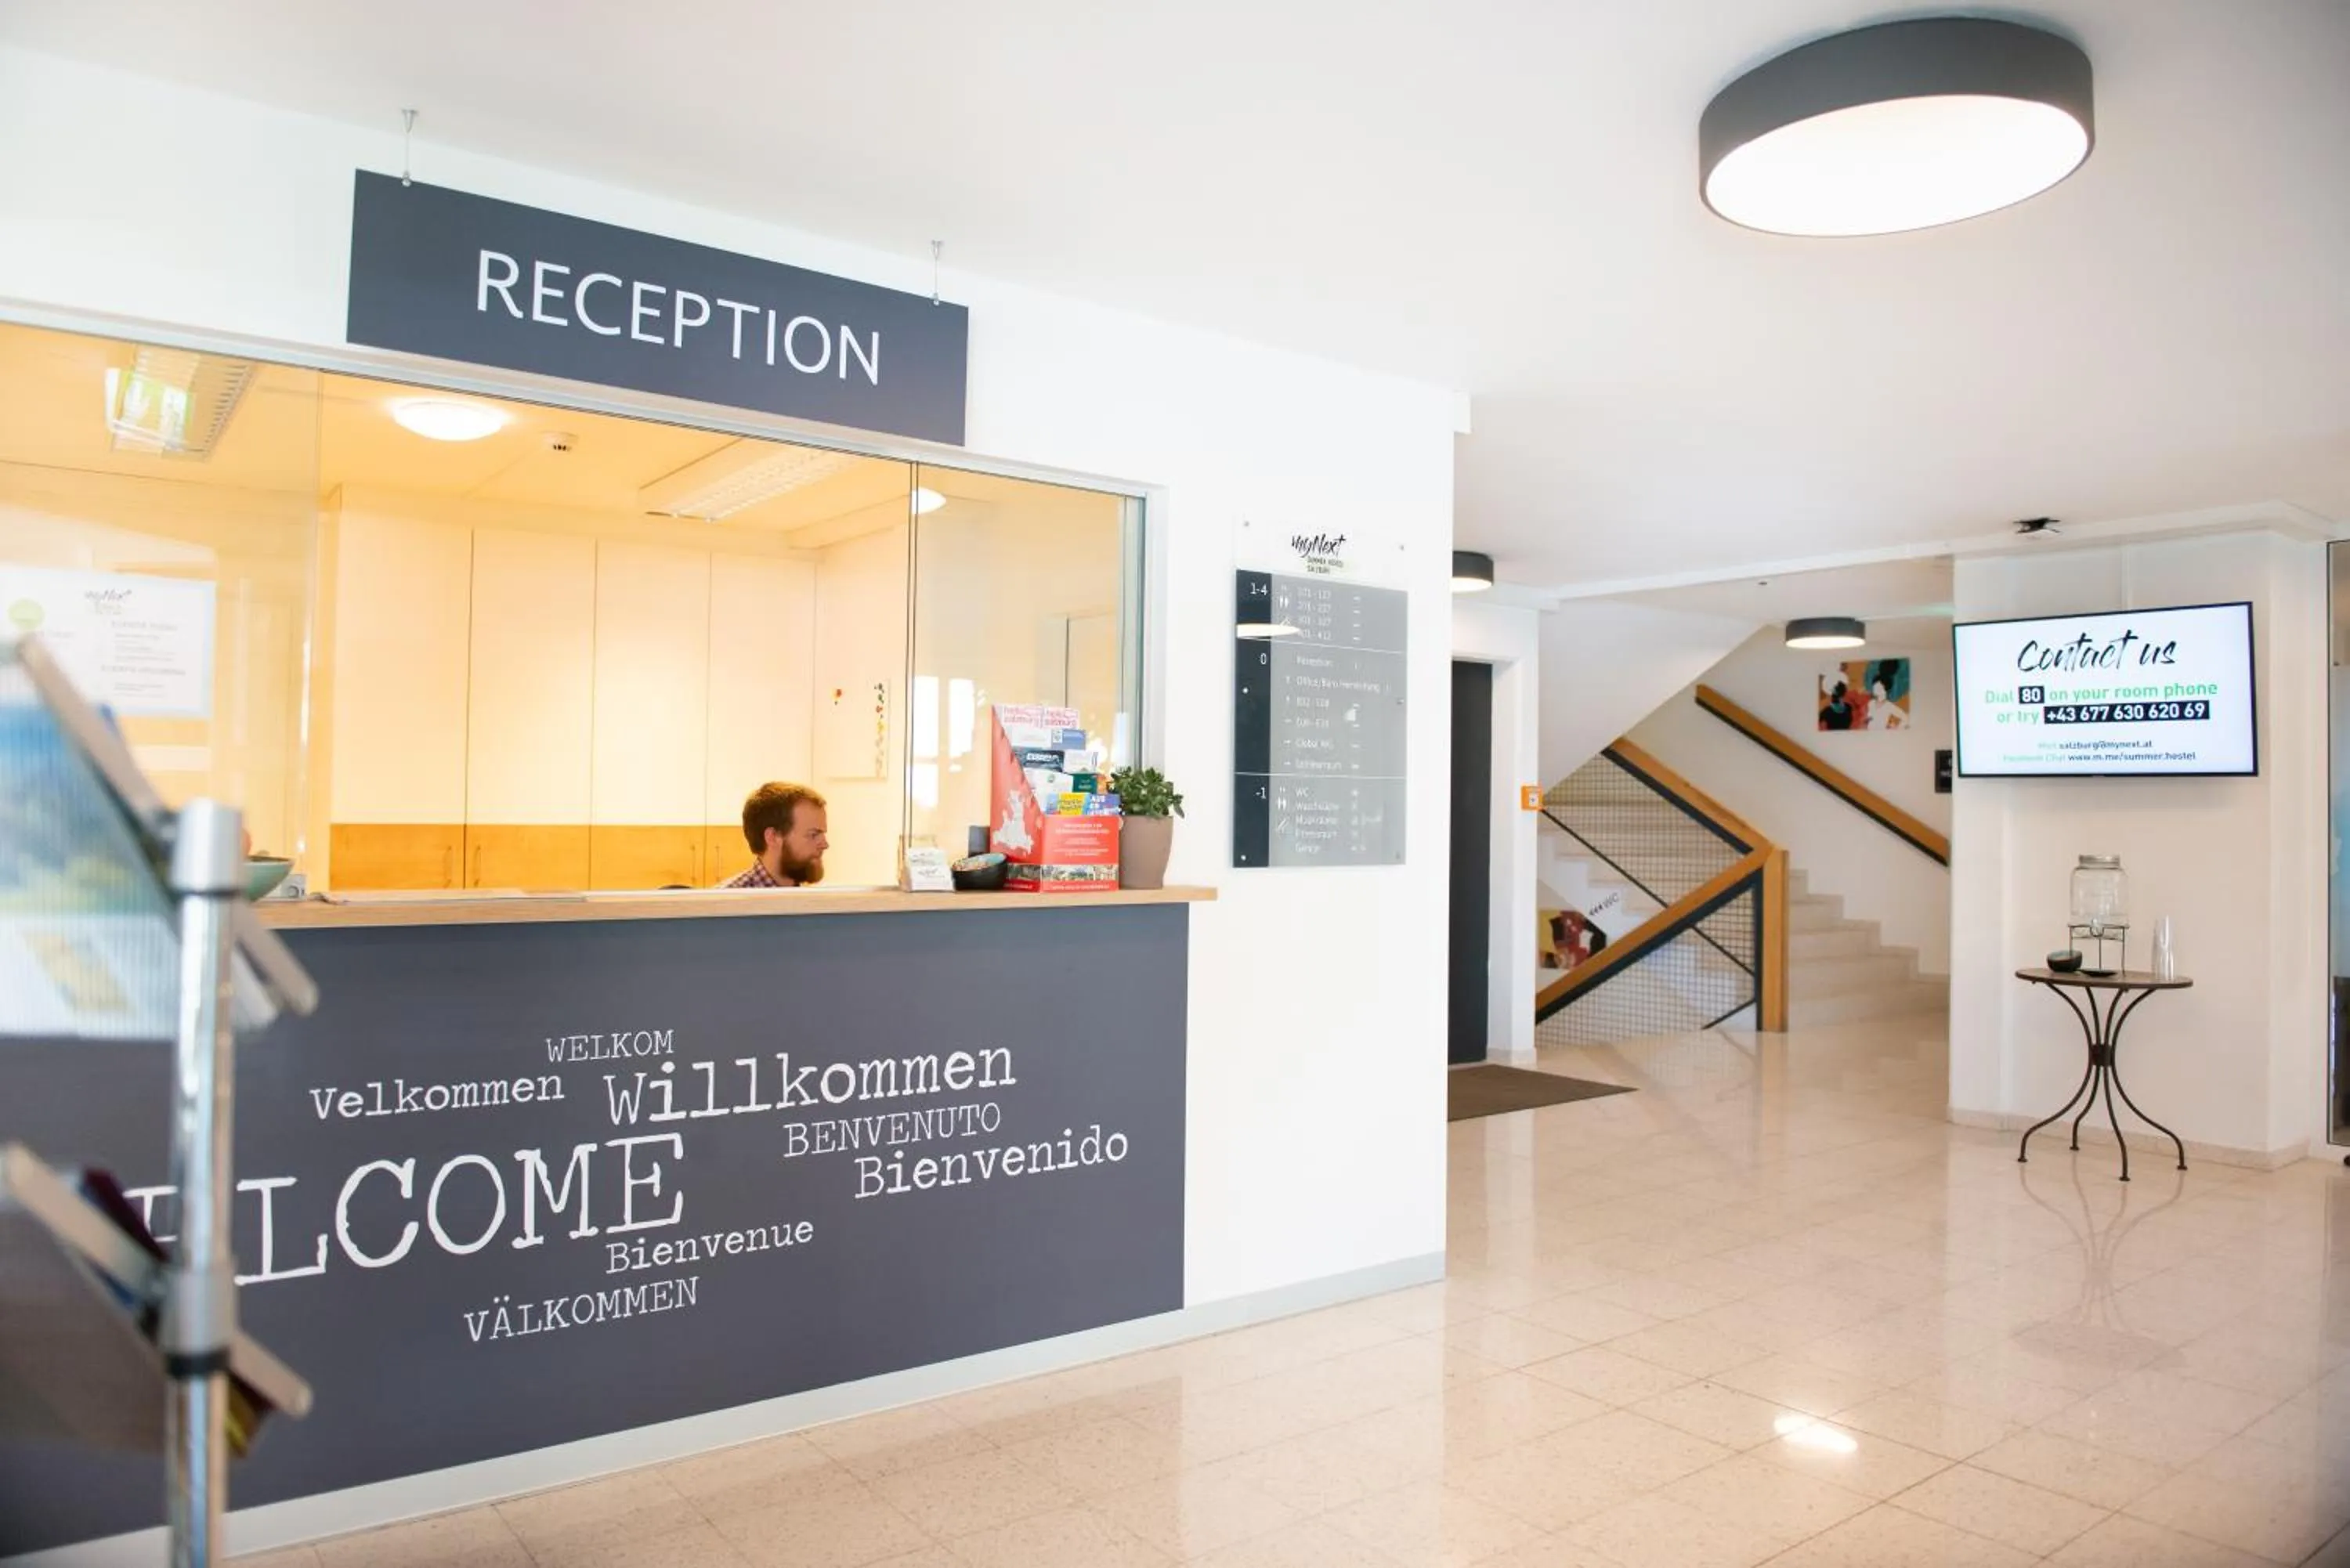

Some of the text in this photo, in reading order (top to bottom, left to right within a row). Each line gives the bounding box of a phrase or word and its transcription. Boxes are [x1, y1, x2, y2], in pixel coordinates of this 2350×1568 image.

[476, 248, 880, 386] RECEPTION
[1250, 582, 1267, 596] 1-4
[2017, 629, 2177, 672] Contact us
[1985, 681, 2218, 706] Dial 80 on your room phone
[1997, 703, 2206, 726] or try +43 677 630 620 69
[1256, 787, 1267, 799] -1
[545, 1029, 675, 1064] WELKOM
[309, 1075, 565, 1120] Velkommen
[603, 1046, 1017, 1126] Willkommen
[783, 1102, 1002, 1158] BENVENUTO
[854, 1125, 1129, 1199] Bienvenido
[121, 1132, 684, 1286] LCOME
[605, 1219, 814, 1274] Bienvenue
[463, 1276, 700, 1342] VÄLKOMMEN
